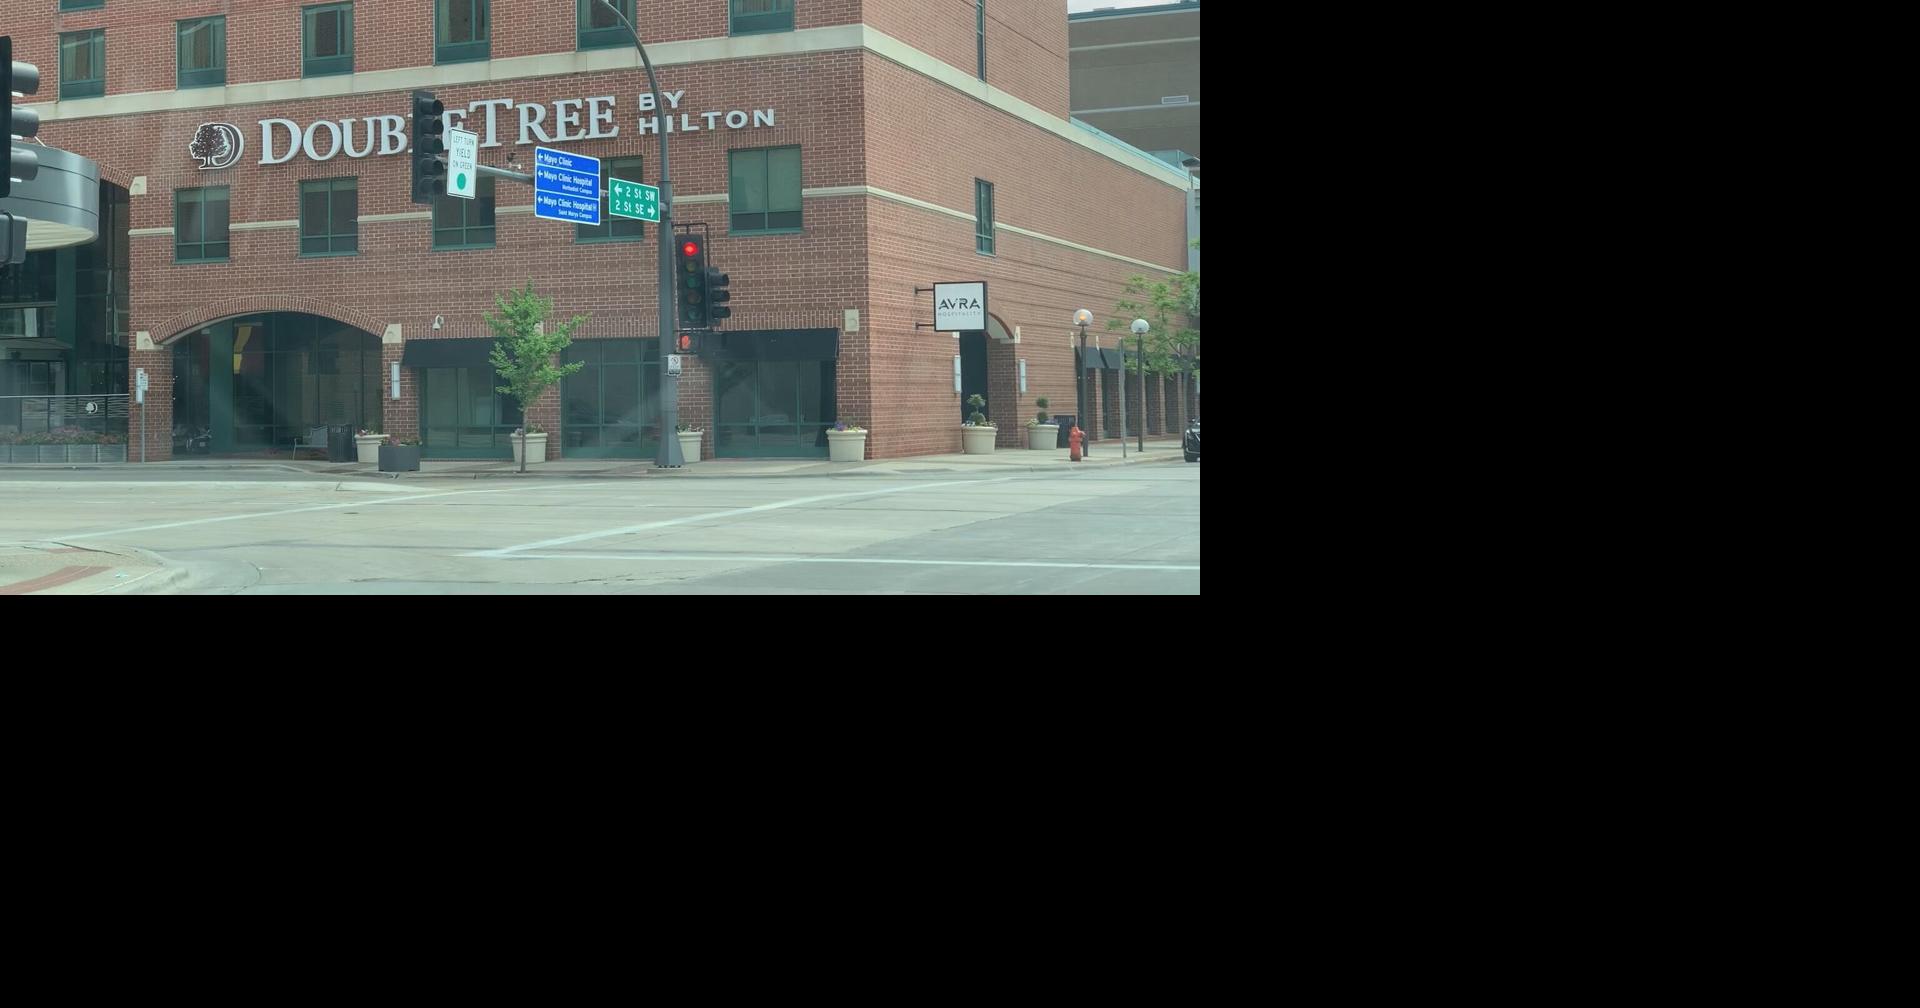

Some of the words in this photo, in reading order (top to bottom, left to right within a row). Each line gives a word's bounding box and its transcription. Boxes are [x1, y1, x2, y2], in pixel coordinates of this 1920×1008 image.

[639, 90, 685, 111] BY
[639, 108, 775, 135] HILTON
[257, 95, 620, 165] DOUBETREE
[453, 135, 463, 143] LEFT
[464, 136, 474, 146] TURN
[456, 148, 471, 159] YIELD
[544, 153, 558, 165] Mayo
[559, 156, 573, 167] Clinic
[453, 160, 459, 168] ON
[460, 161, 472, 170] GREEN
[543, 170, 557, 182] Mayo
[558, 173, 572, 183] Clinic
[573, 175, 593, 187] Hospital
[626, 186, 631, 197] 2
[634, 188, 642, 199] St
[645, 190, 655, 202] SW
[543, 196, 557, 208] Mayo
[558, 198, 572, 208] Clinic
[573, 200, 592, 212] Hospital
[615, 199, 620, 210] 2
[624, 201, 632, 212] St
[635, 203, 644, 215] SE
[938, 297, 981, 310] AVRA
